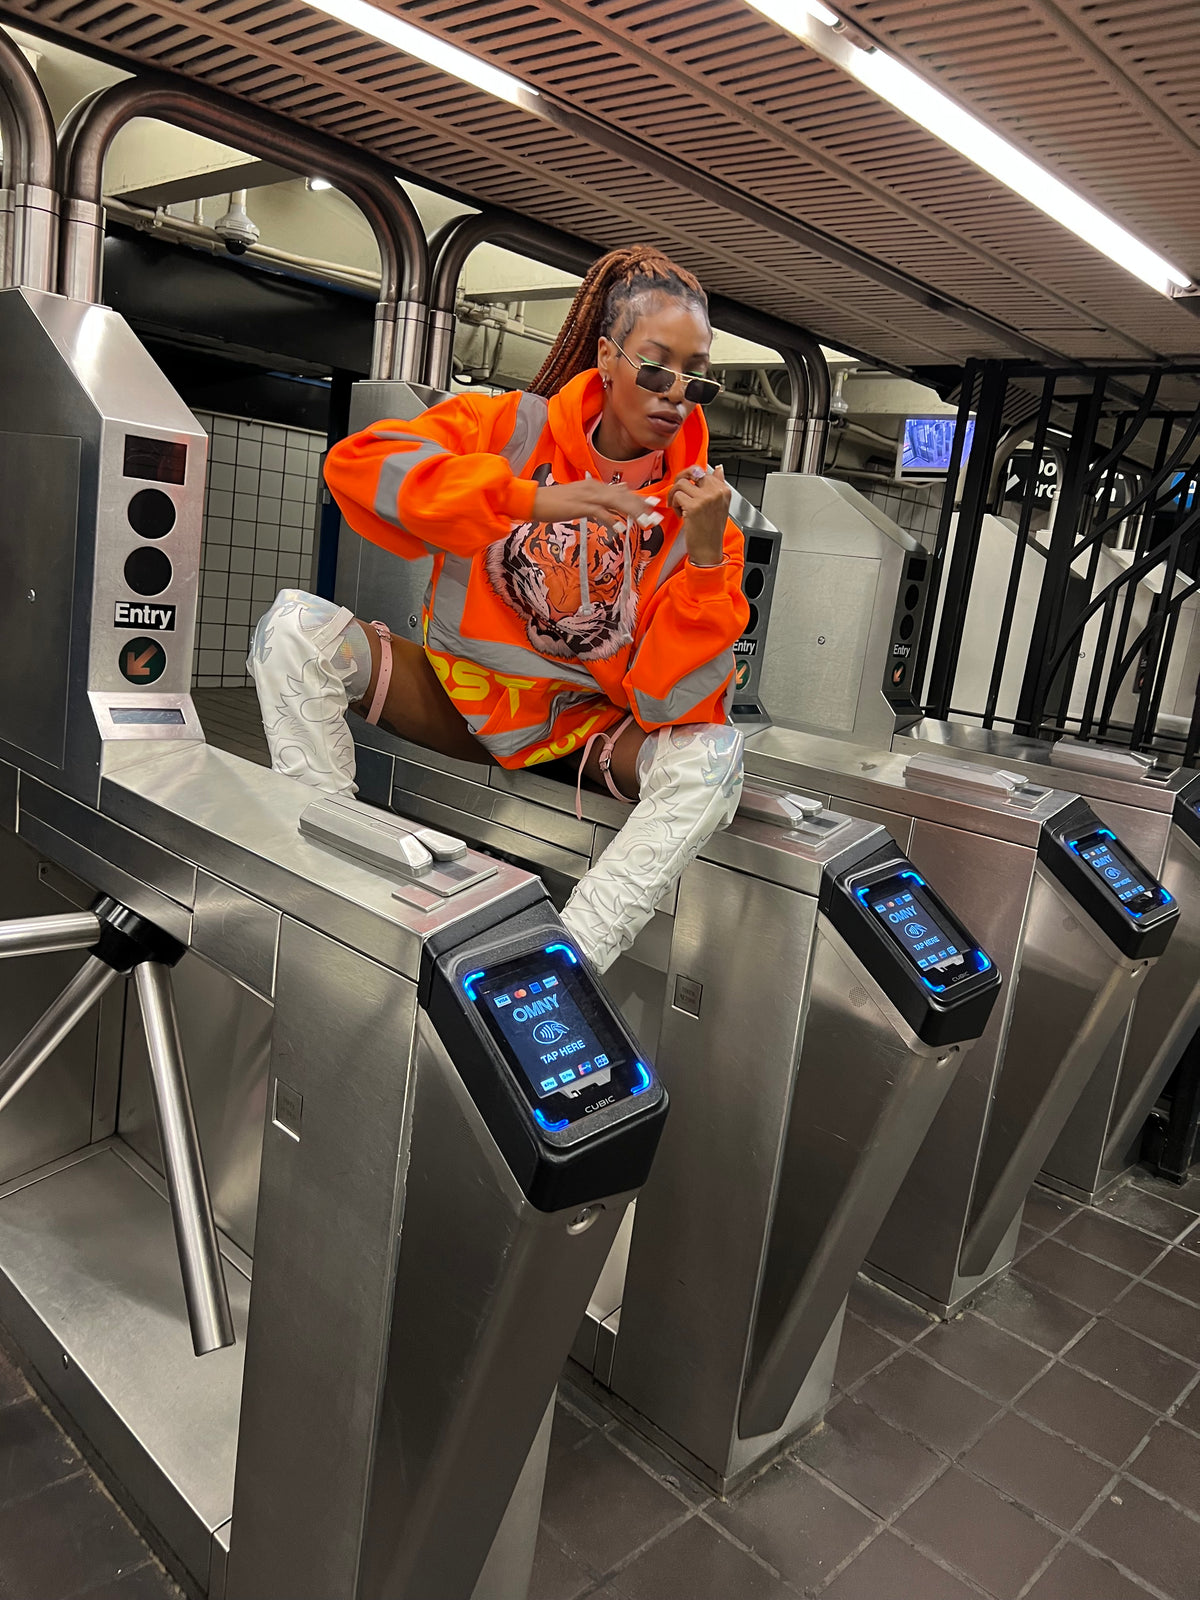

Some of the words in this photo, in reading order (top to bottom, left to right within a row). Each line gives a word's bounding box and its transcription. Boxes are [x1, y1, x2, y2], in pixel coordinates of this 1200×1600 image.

[114, 602, 172, 629] Entry
[732, 640, 755, 655] Entry
[893, 644, 910, 658] Entry
[888, 905, 917, 924] OMNY
[513, 993, 559, 1022] OMNY
[540, 1051, 558, 1064] TAP
[559, 1039, 586, 1057] HERE
[584, 1095, 615, 1113] CUBIC
